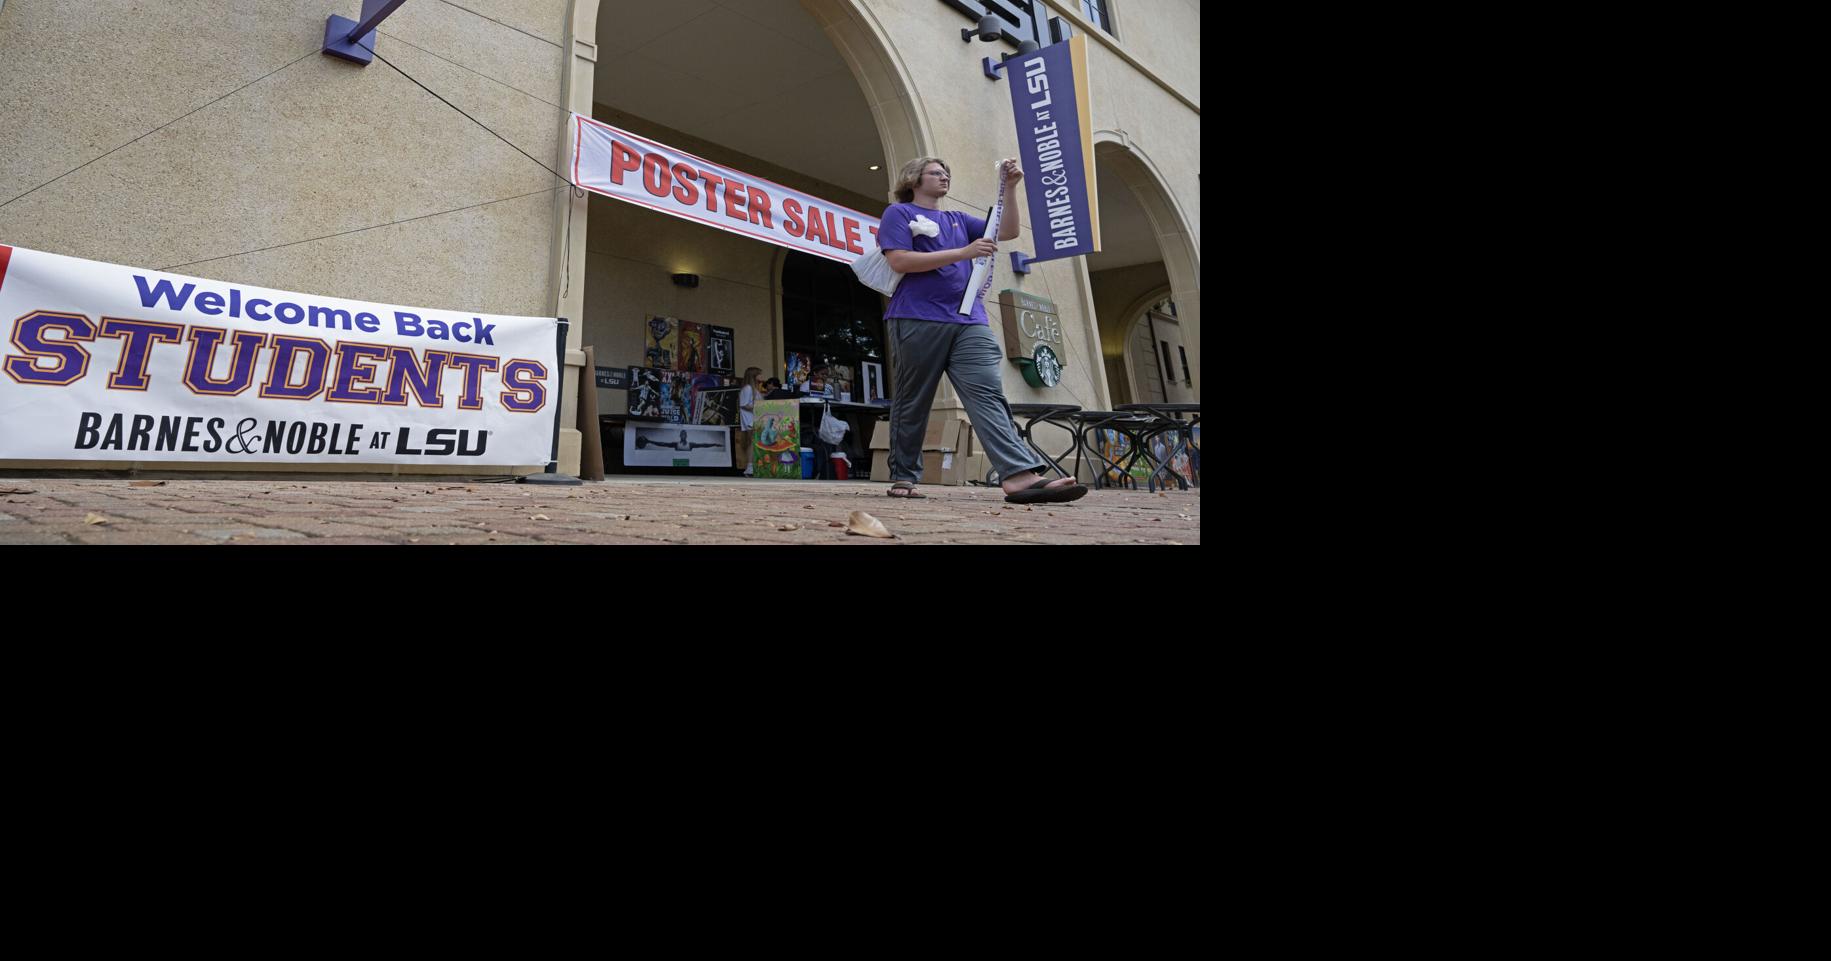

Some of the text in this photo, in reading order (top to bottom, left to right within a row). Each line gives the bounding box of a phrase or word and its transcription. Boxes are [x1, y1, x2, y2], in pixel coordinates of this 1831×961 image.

[1024, 56, 1052, 110] LSU
[1036, 110, 1050, 121] AT
[610, 140, 865, 256] POSTER SALE
[132, 274, 496, 346] Welcome Back
[1021, 310, 1061, 344] Café
[3, 309, 548, 414] STUDENTS
[368, 431, 391, 450] AT
[394, 426, 489, 457] LSU
